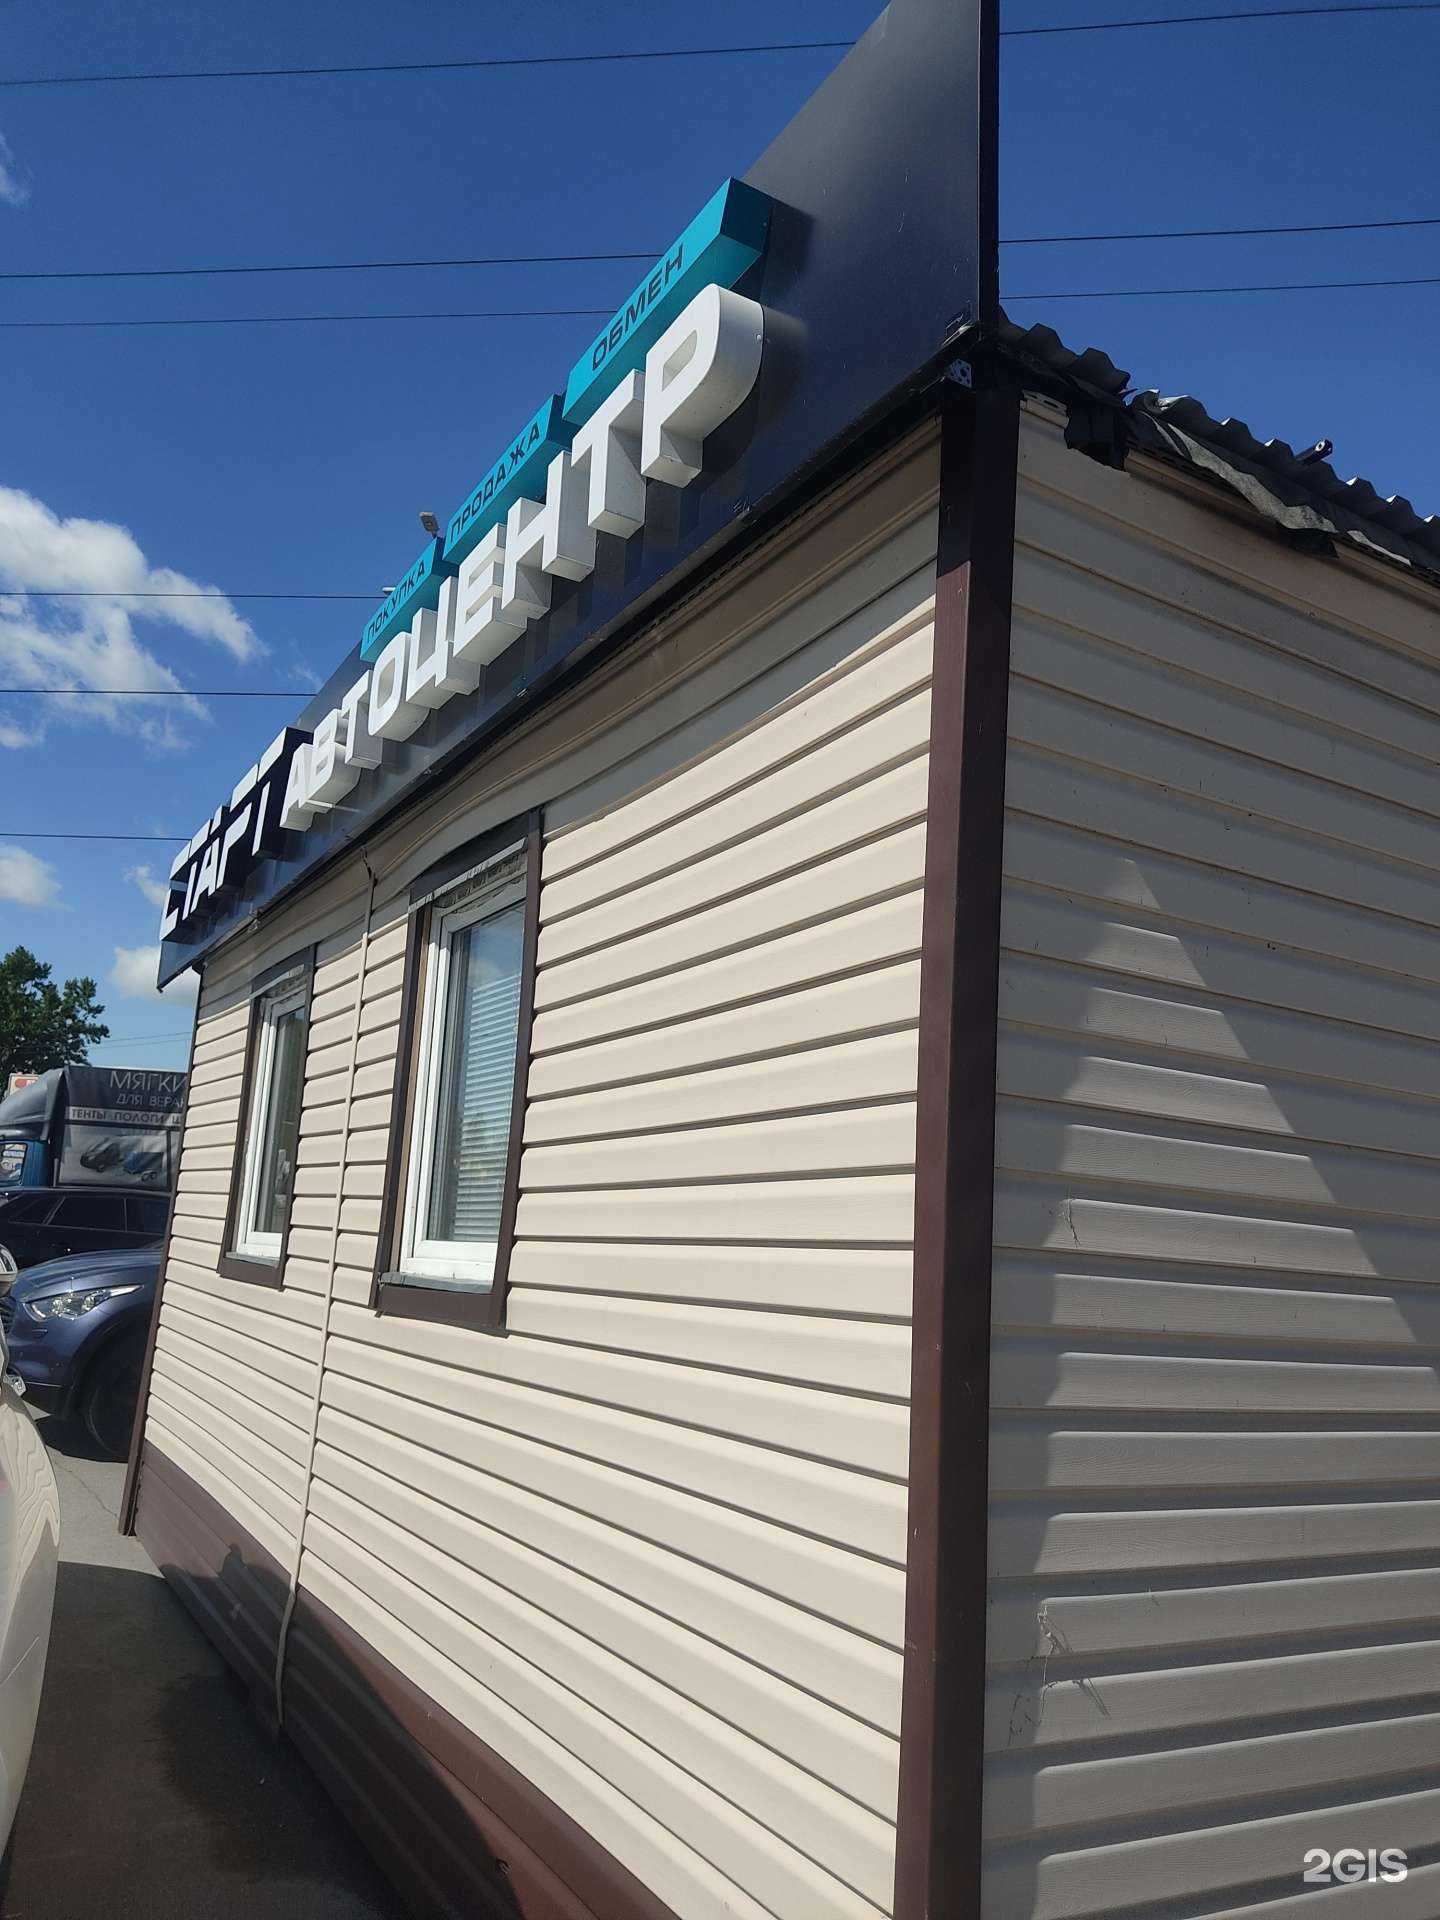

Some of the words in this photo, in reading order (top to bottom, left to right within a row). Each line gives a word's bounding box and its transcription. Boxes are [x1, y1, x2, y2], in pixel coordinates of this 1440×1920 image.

[367, 558, 425, 643] ПОКУПКА
[450, 422, 540, 543] ПРОДАЖА
[591, 243, 684, 371] ОБМЕН
[159, 726, 288, 942] СТАРТ
[279, 283, 764, 831] АВТОЦЕНТР
[71, 1108, 106, 1120] ТЕНТЫ
[116, 1093, 143, 1105] ДЛЯ
